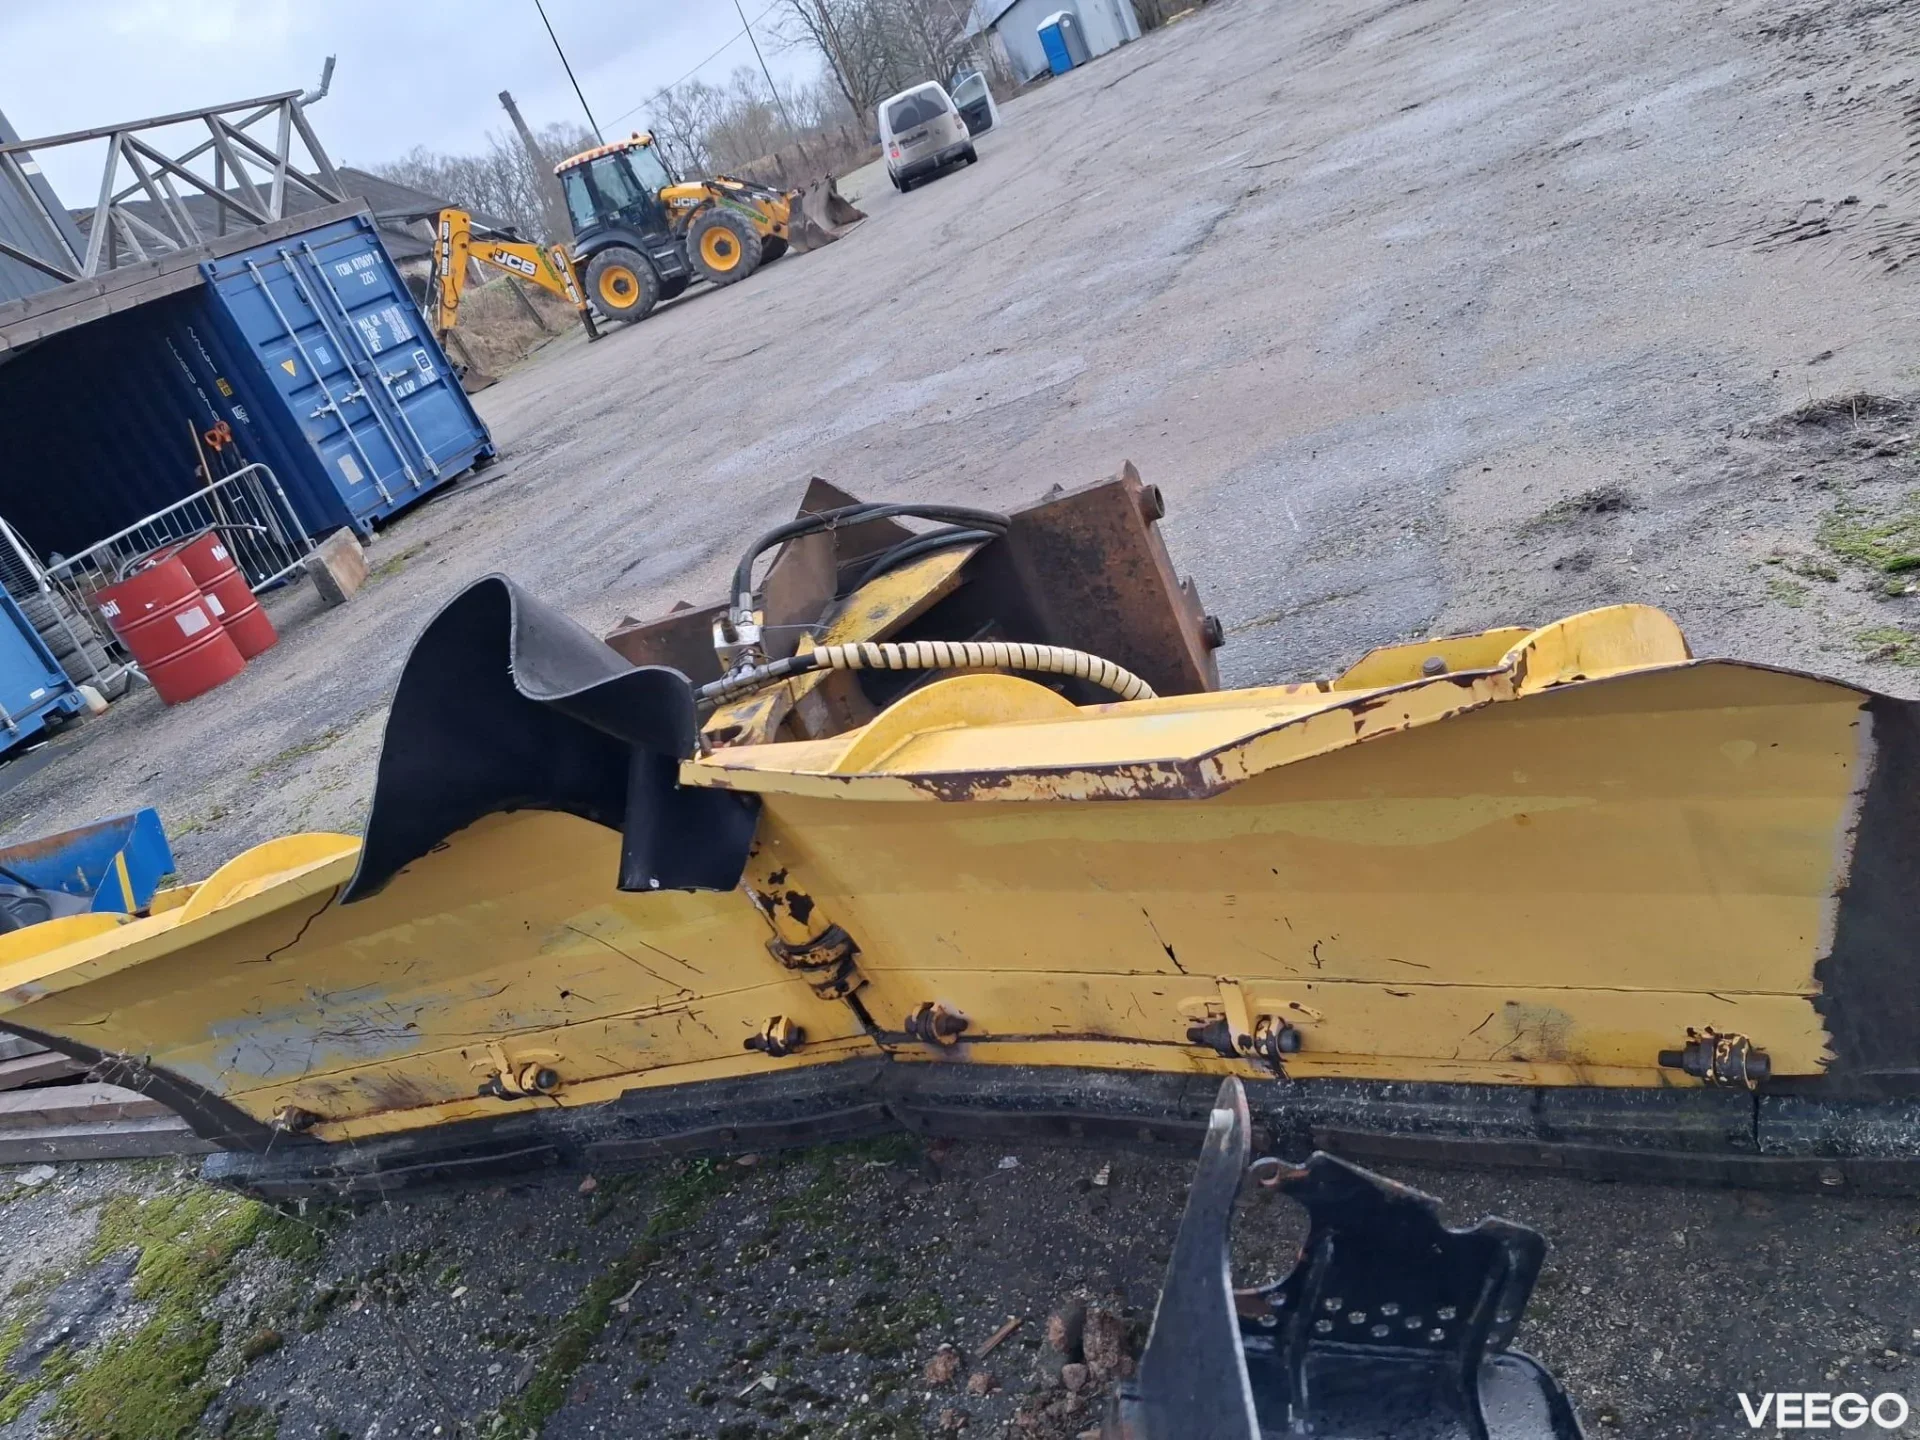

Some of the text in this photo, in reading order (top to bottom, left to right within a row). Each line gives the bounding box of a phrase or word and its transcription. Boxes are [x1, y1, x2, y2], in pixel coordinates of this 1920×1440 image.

[673, 197, 699, 207] JCB
[494, 250, 537, 276] JCB
[101, 599, 121, 618] bil
